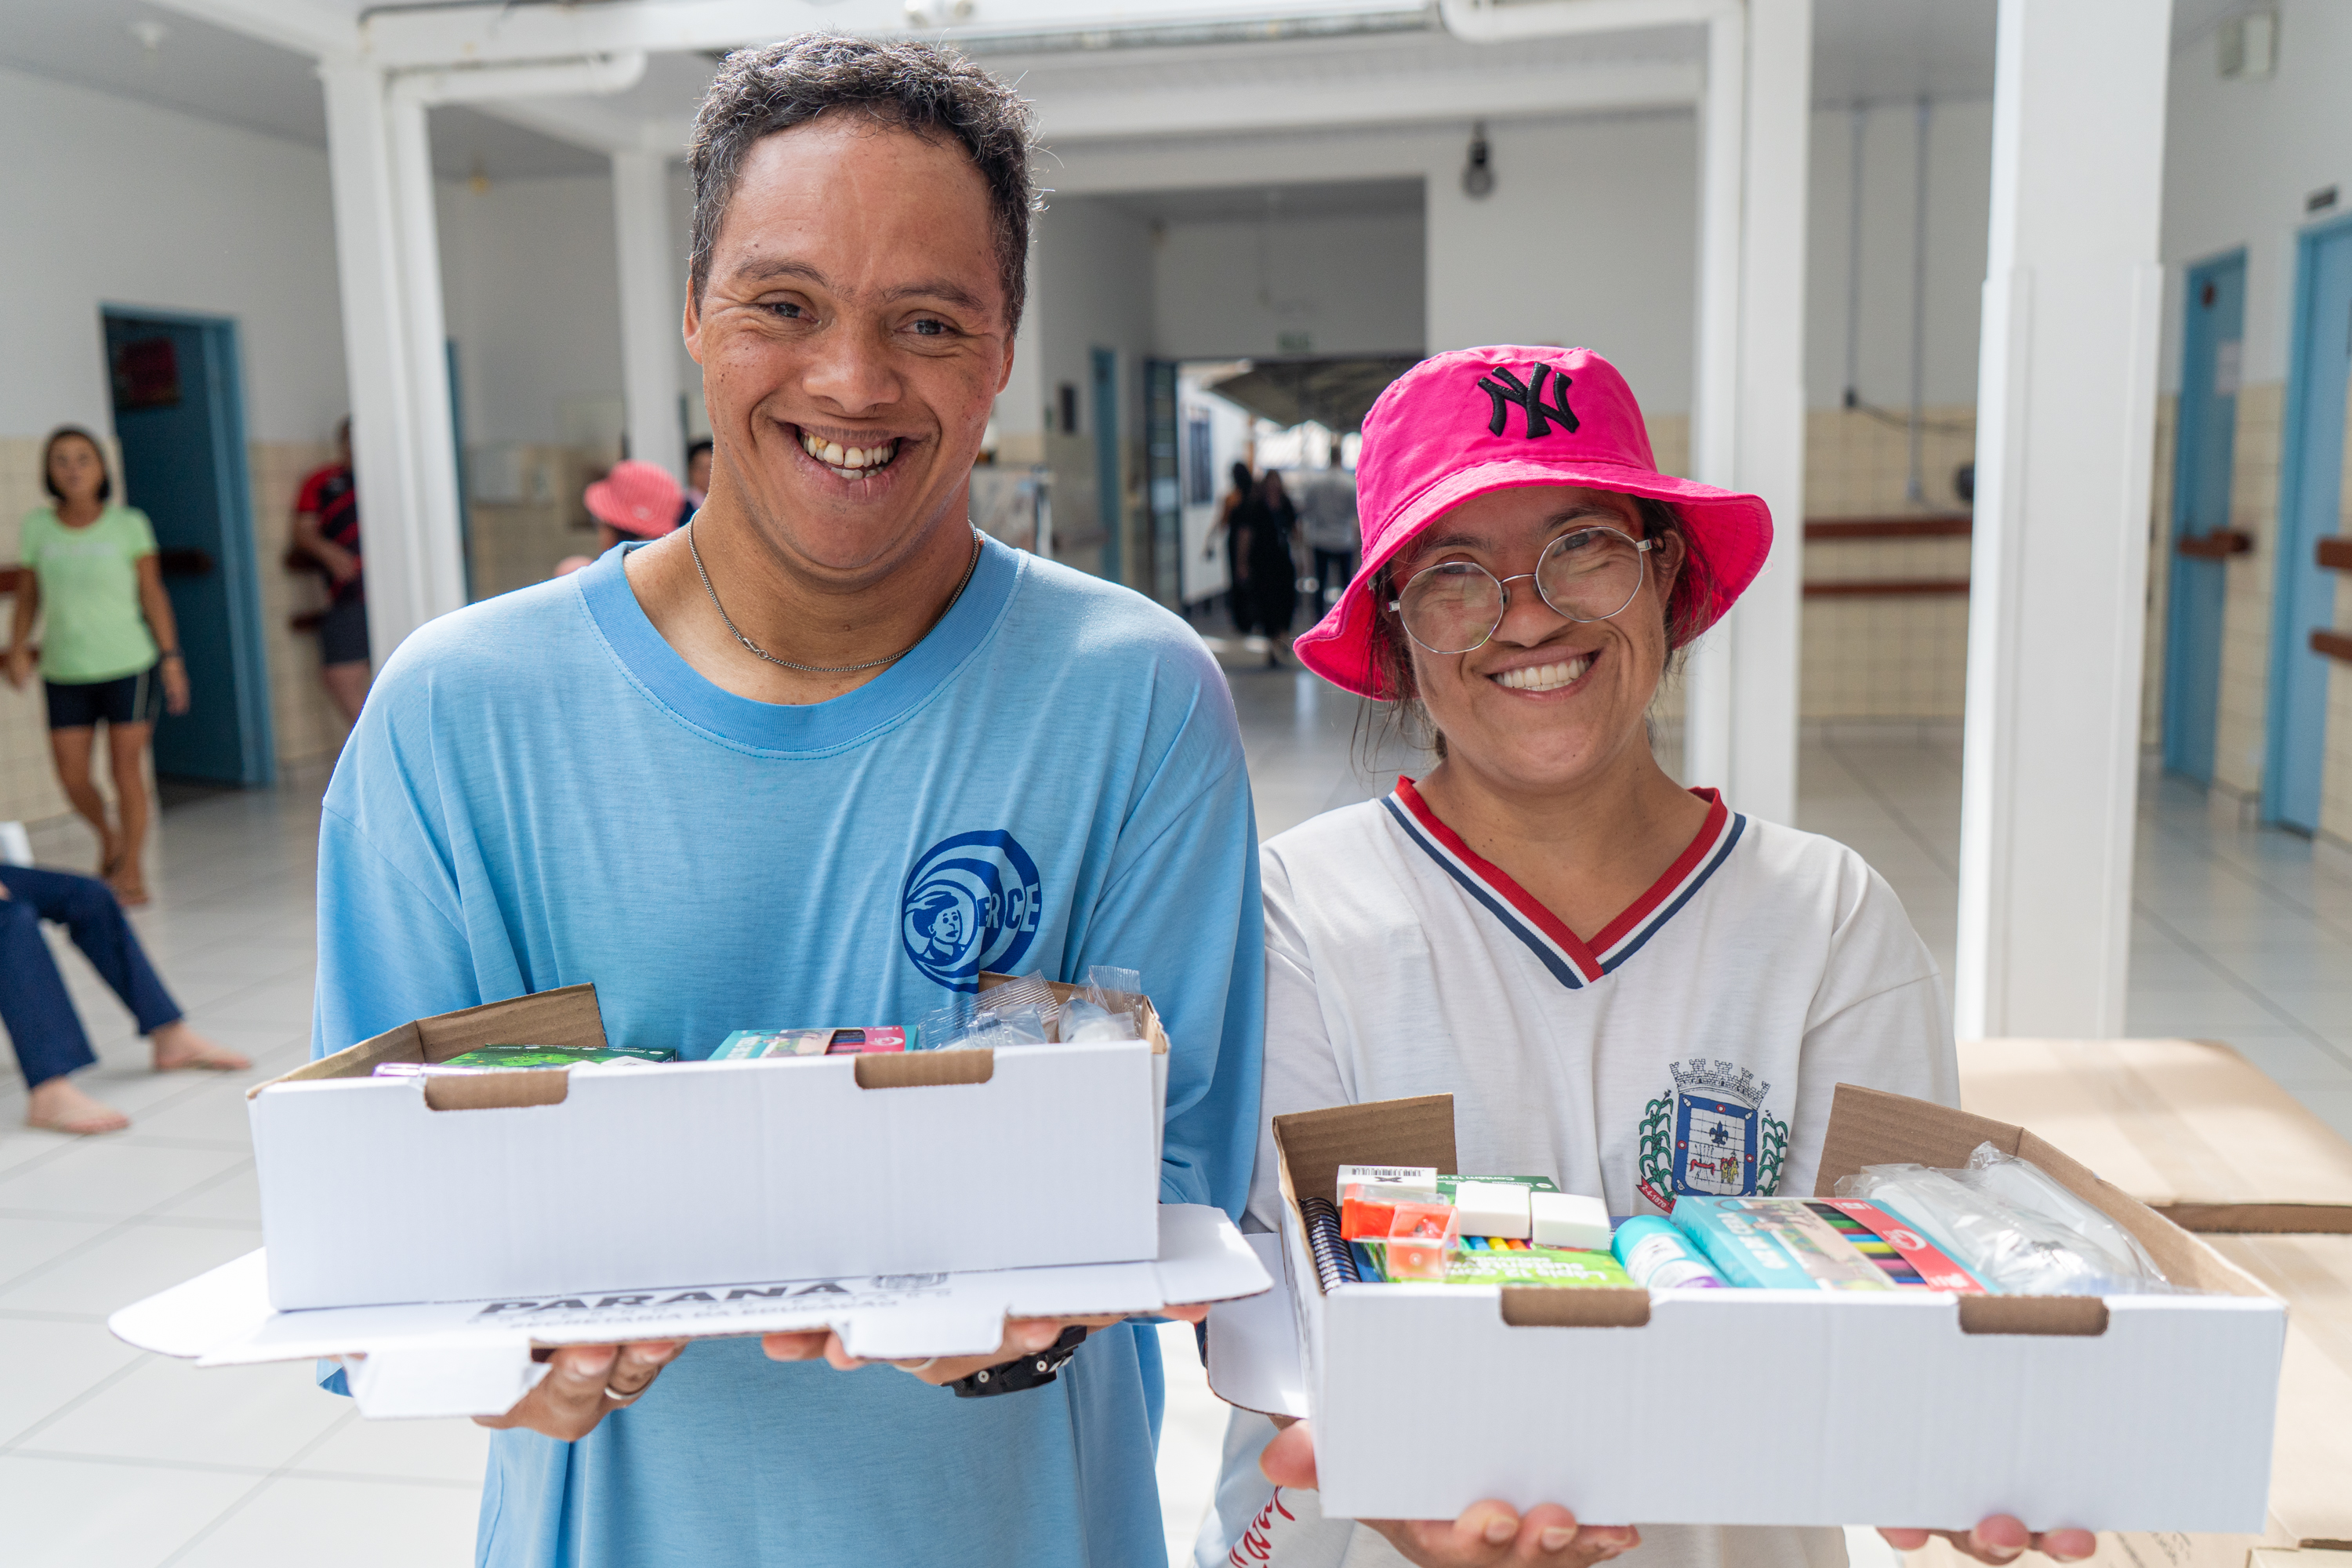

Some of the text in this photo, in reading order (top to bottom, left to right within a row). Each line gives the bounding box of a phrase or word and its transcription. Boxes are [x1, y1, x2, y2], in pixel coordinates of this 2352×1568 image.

[1477, 361, 1581, 439] NY
[1642, 1185, 1667, 1207] 2-4-1870
[480, 1279, 851, 1314] PARANÁ
